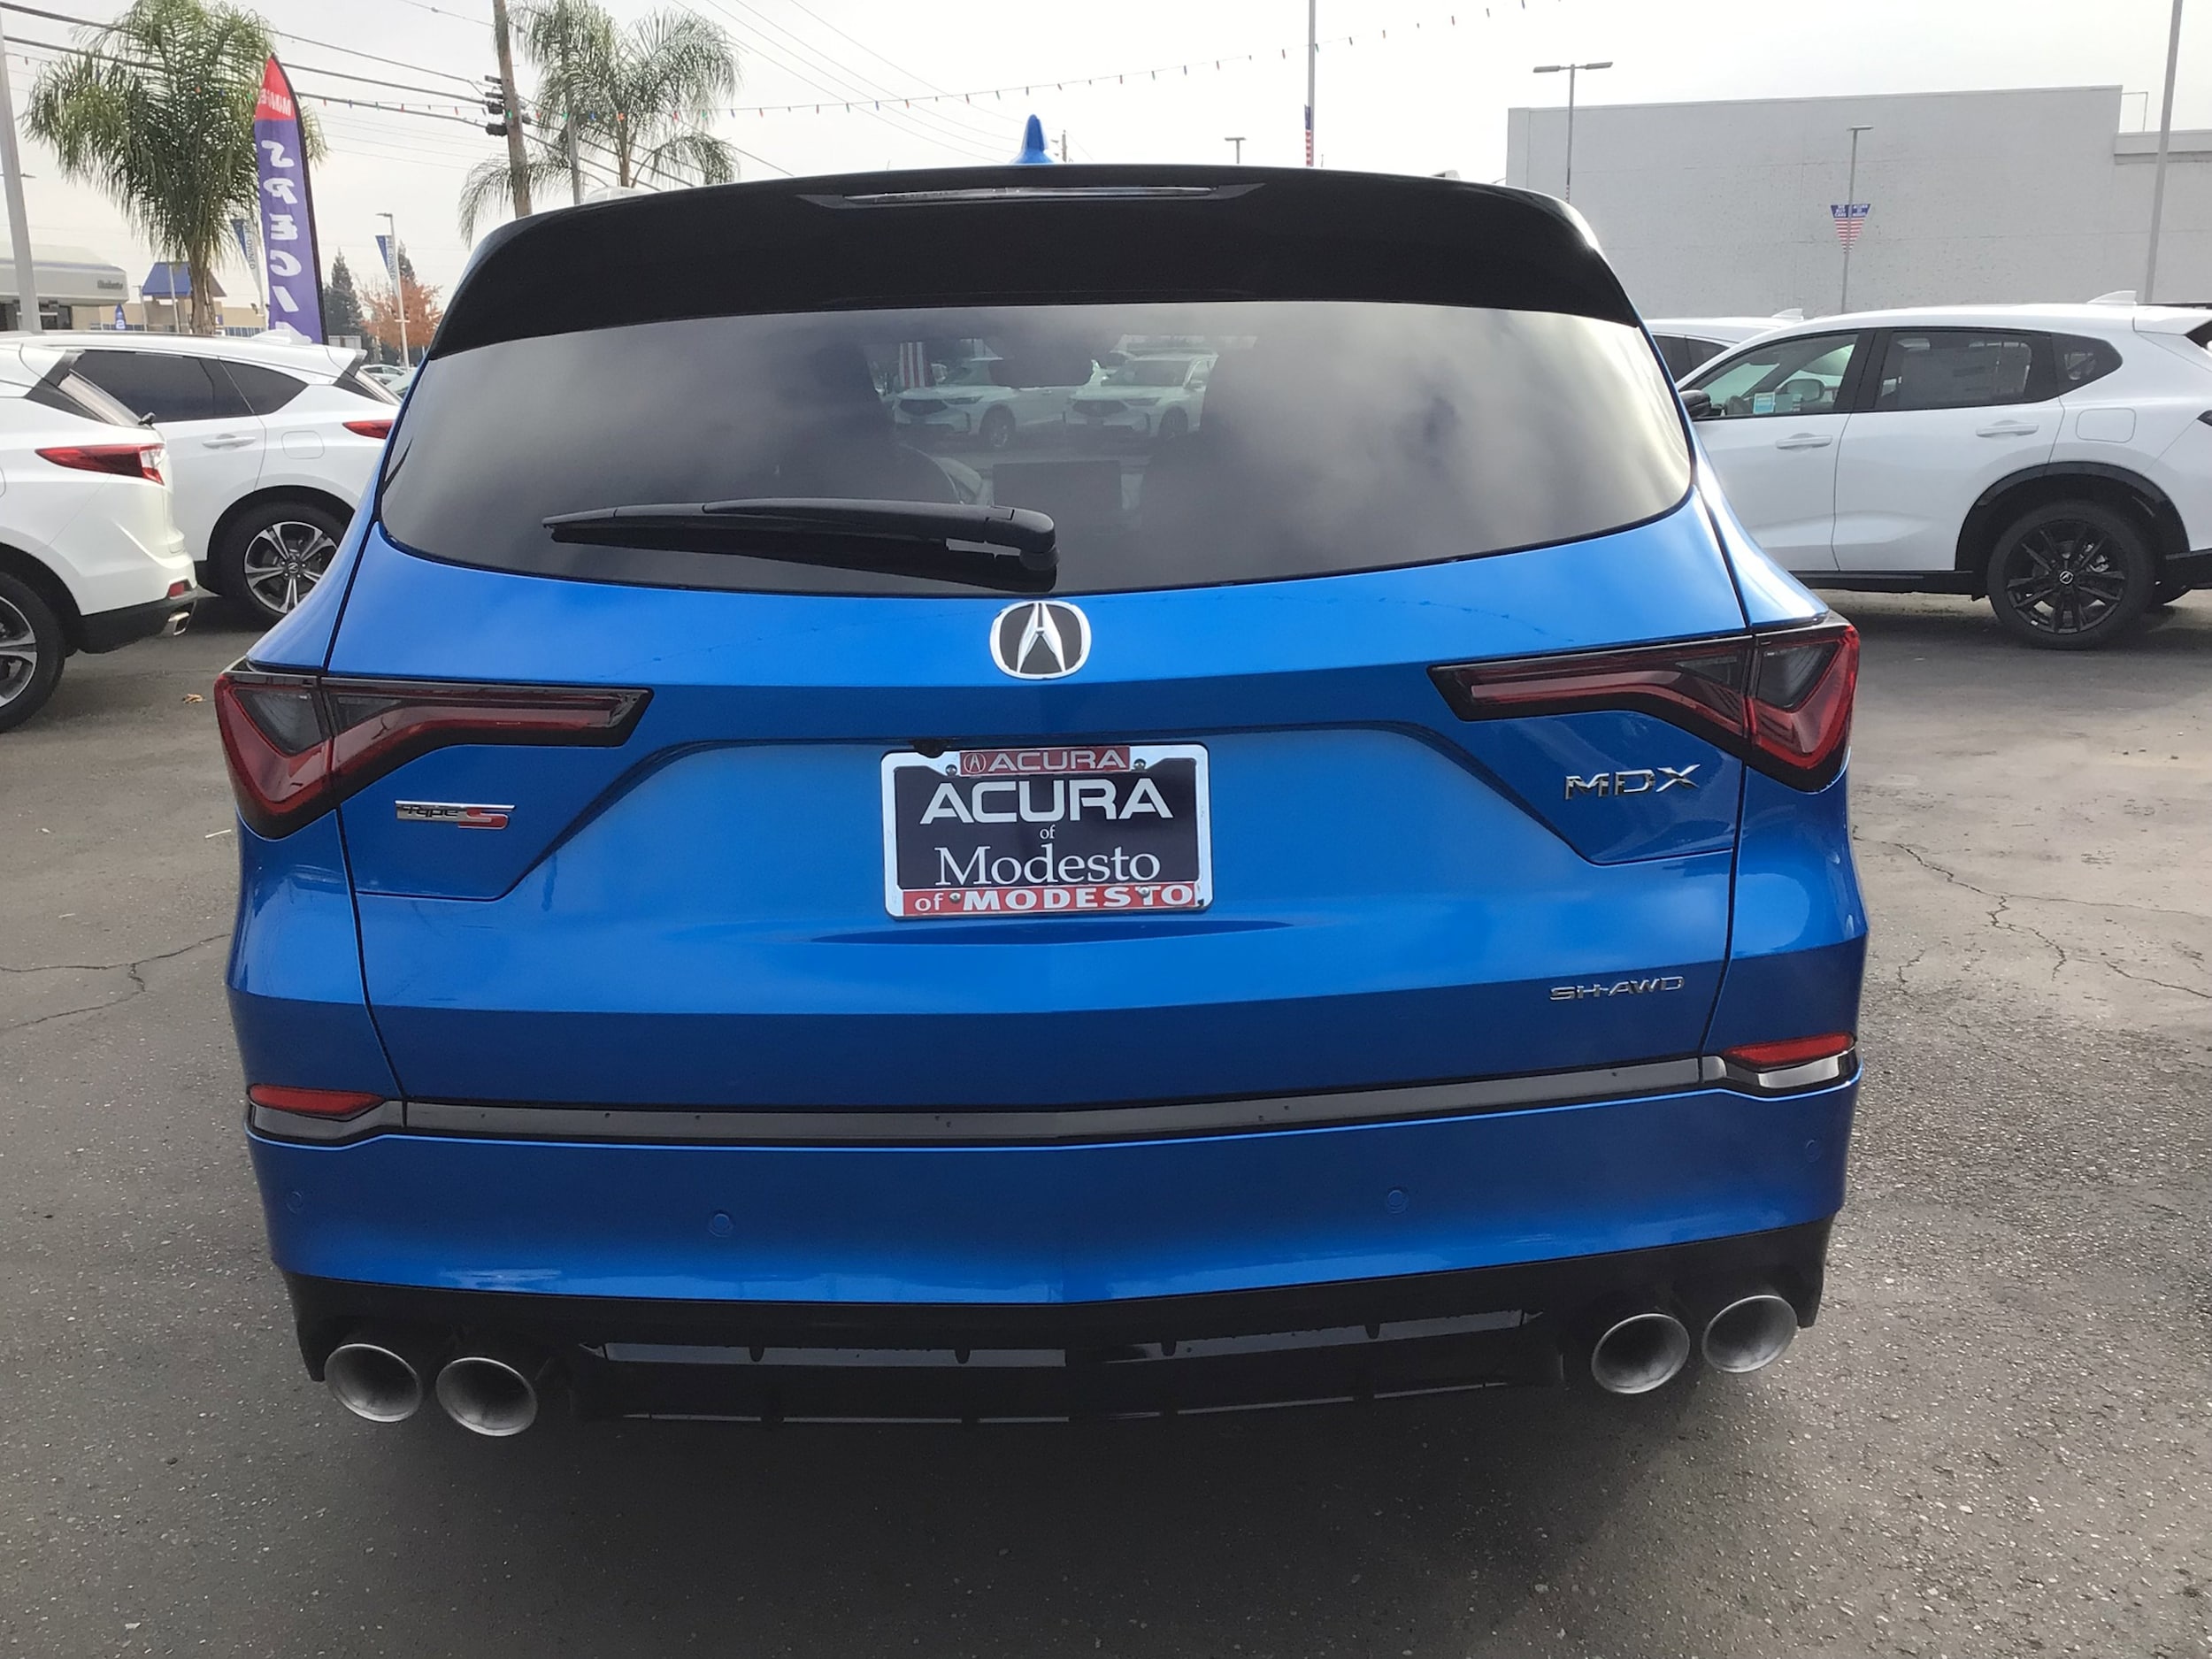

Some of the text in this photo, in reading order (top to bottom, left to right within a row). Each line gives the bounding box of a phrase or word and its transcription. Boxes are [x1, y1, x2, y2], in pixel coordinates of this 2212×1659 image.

[988, 750, 1125, 772] ACURA
[1565, 764, 1701, 800] MDX
[919, 778, 1174, 825] ACURA
[457, 807, 509, 829] S
[1040, 825, 1056, 840] of
[934, 843, 1161, 887] Modesto
[915, 885, 1194, 912] of MODESTO
[1550, 977, 1684, 1001] SH-AWD
